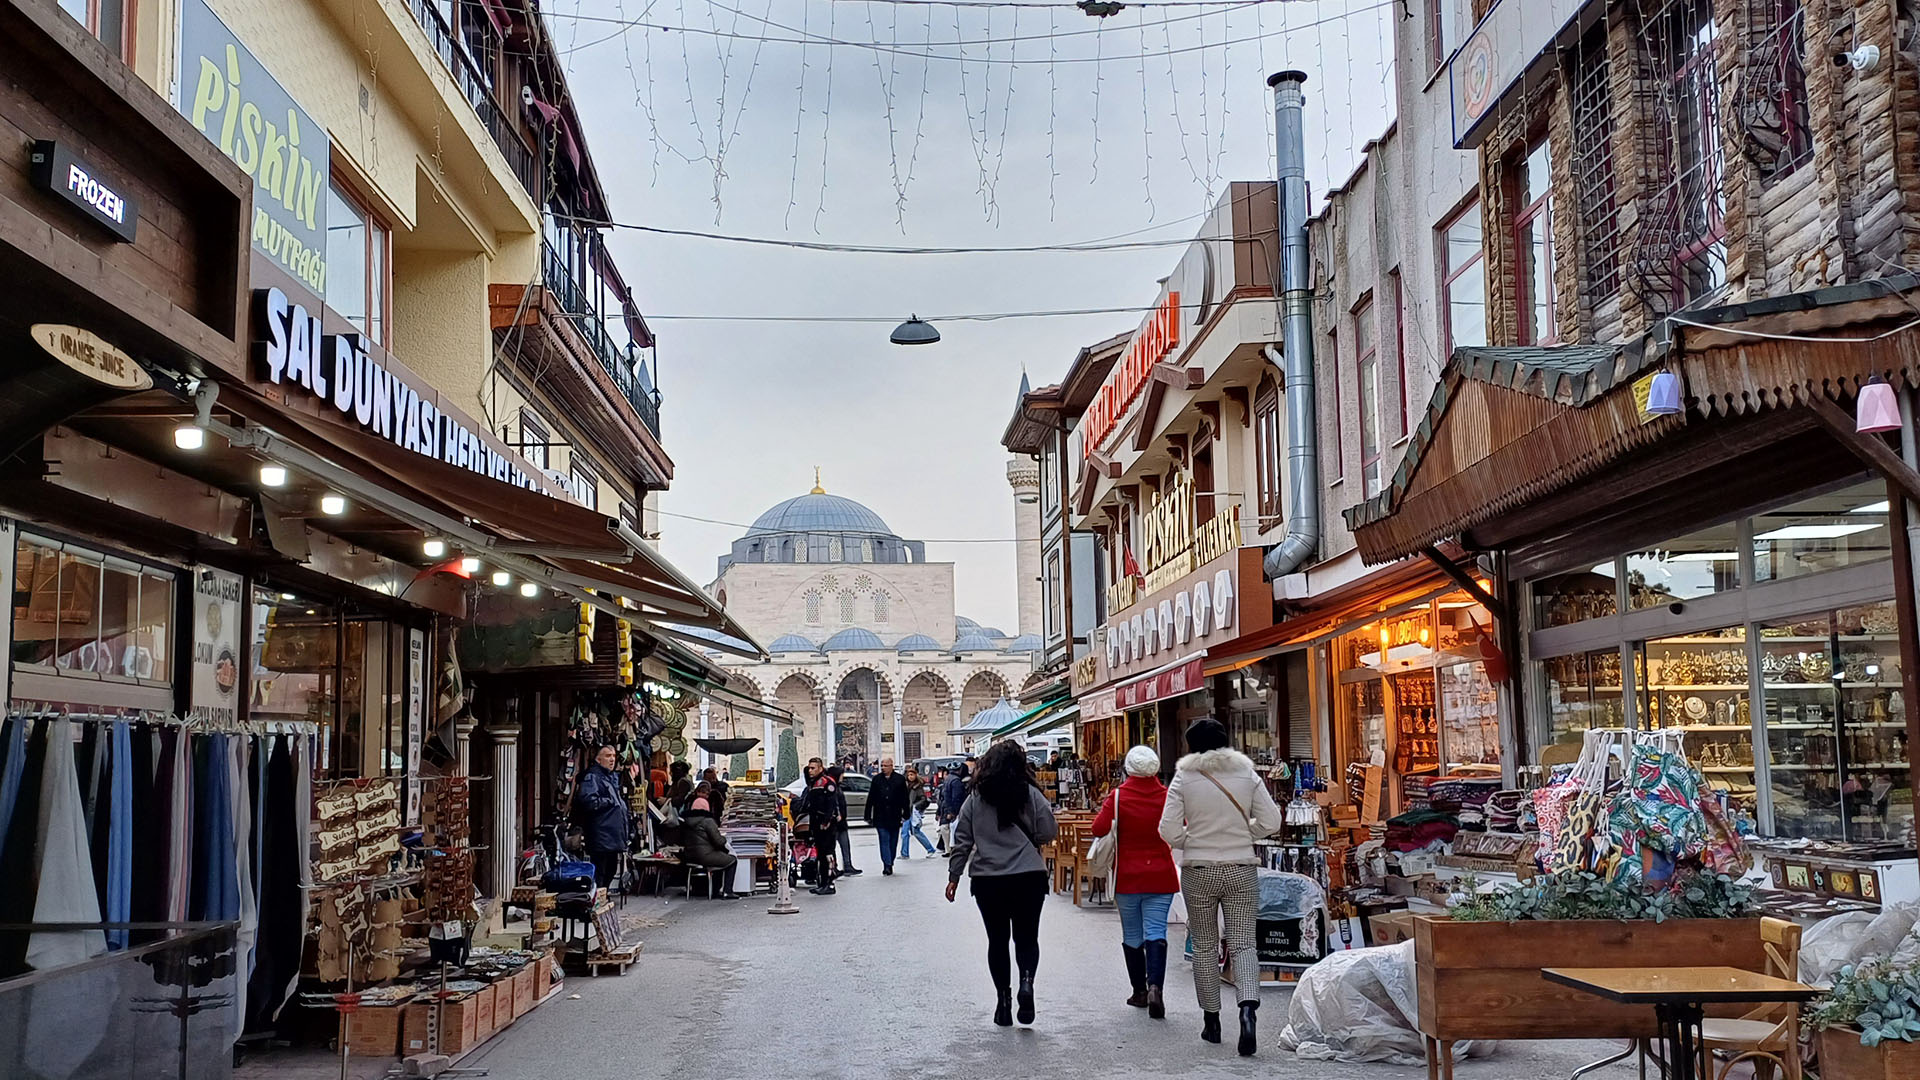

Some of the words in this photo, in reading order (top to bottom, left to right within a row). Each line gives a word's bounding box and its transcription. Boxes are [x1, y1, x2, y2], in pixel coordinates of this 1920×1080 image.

[67, 163, 125, 224] FROZEN
[252, 207, 326, 293] MUTFAĞI
[60, 333, 95, 367] ORANGE
[99, 350, 125, 379] JUICE
[266, 286, 327, 399] ŞAL
[335, 330, 440, 460] DÜNYASI
[1113, 291, 1180, 420] LOKANTASI
